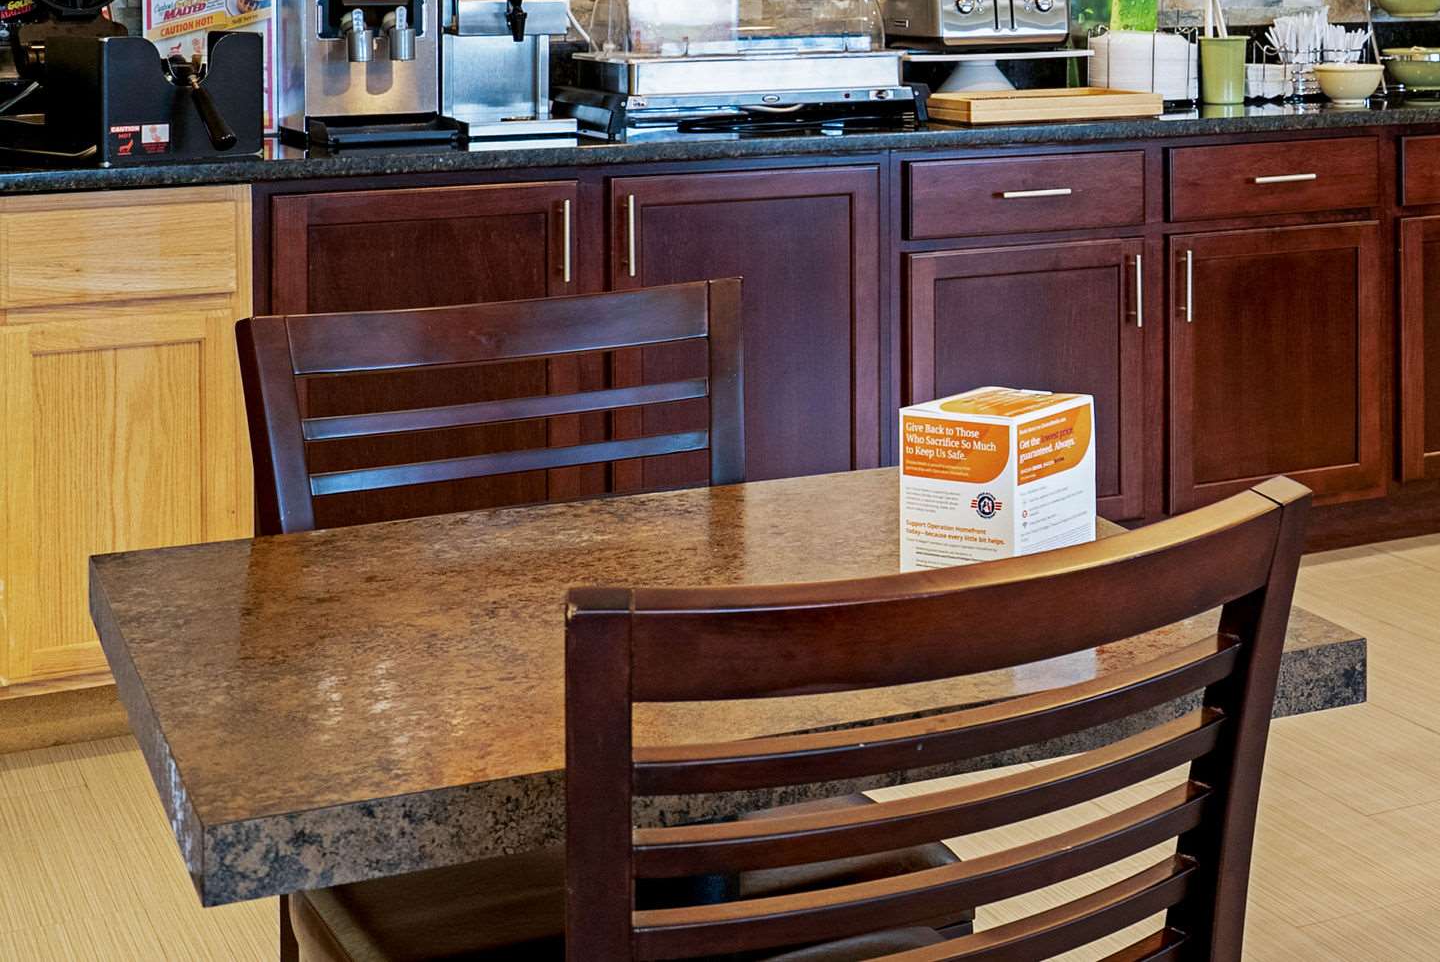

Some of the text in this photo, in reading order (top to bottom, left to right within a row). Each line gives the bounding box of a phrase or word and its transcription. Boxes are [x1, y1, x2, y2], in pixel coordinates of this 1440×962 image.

[163, 3, 206, 20] MALTED
[160, 16, 214, 37] CAUTION HOT!
[906, 422, 980, 438] Give Back to Those
[906, 433, 997, 451] Who Sacrifice So Much
[906, 446, 967, 460] to Keep Us Safe.
